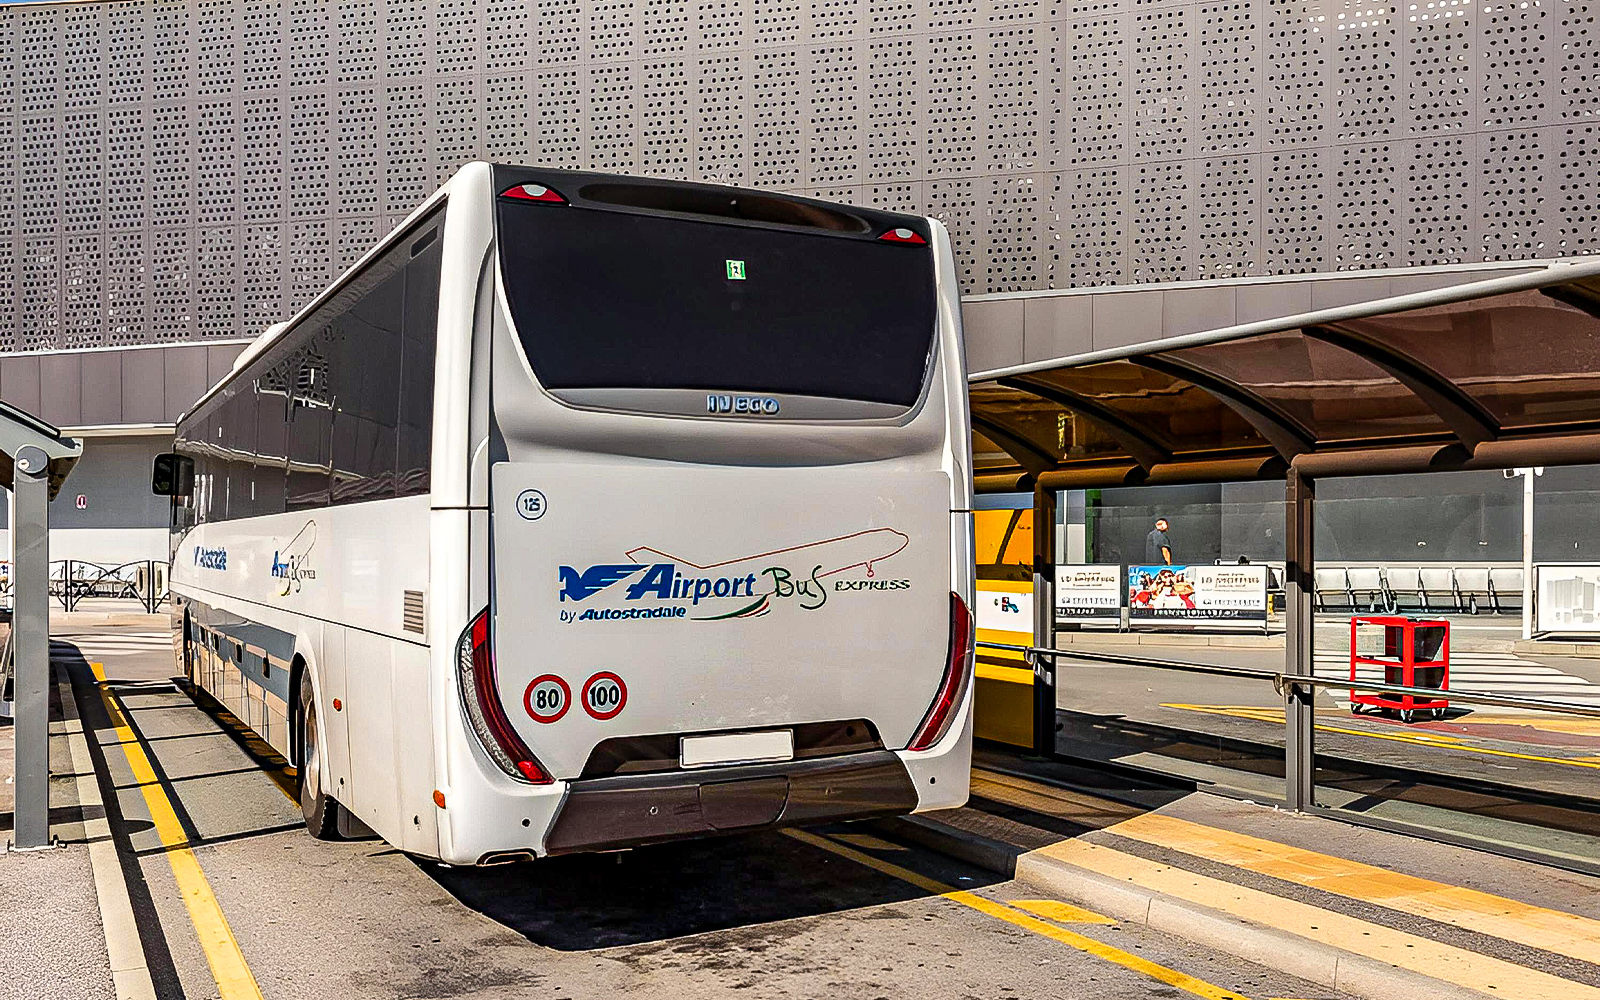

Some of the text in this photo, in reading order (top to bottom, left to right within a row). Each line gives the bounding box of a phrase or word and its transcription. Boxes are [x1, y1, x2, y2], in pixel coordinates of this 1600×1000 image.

[706, 394, 780, 415] IVECO
[625, 563, 911, 610] Airport Bus EXPRESS
[559, 606, 687, 624] by Autostradale
[536, 689, 560, 710] 80
[589, 685, 620, 707] 100
